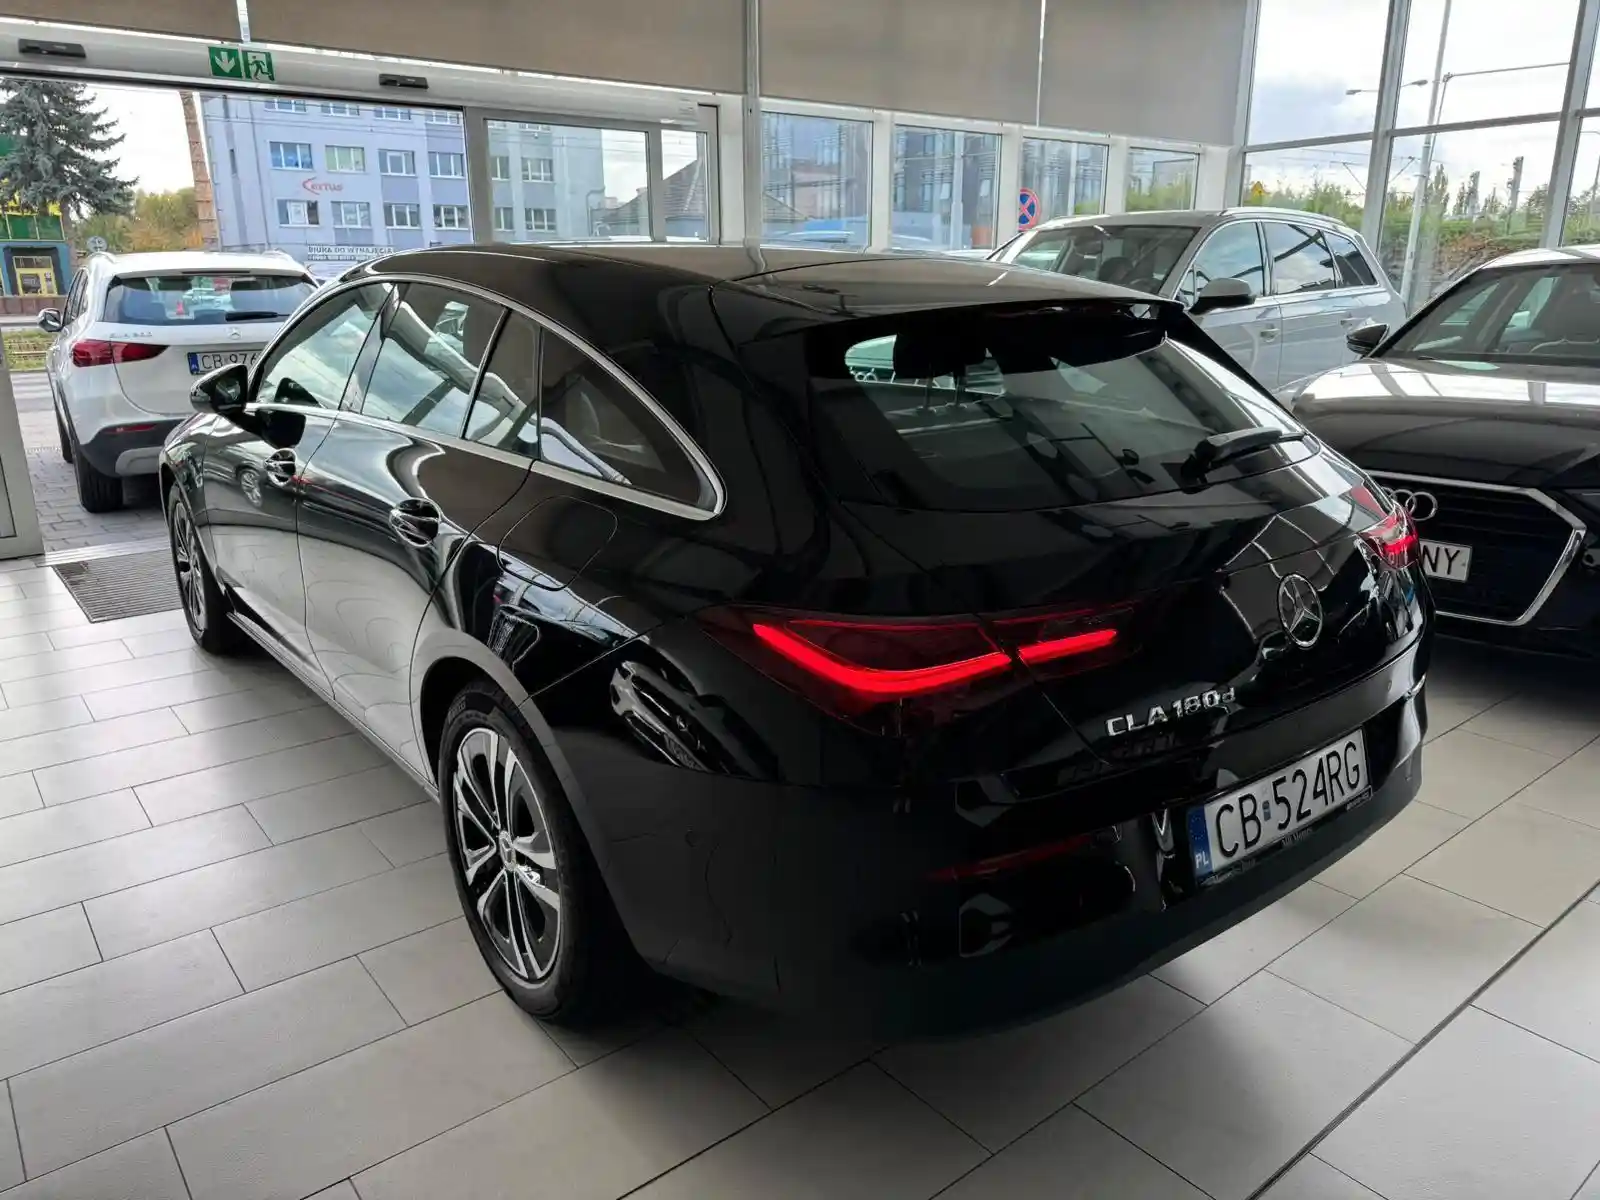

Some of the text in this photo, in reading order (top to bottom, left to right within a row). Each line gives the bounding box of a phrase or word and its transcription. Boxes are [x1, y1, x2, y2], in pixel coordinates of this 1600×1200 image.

[1421, 544, 1460, 575] NY
[1216, 740, 1360, 858] CB 524RG
[1195, 852, 1210, 869] PL
